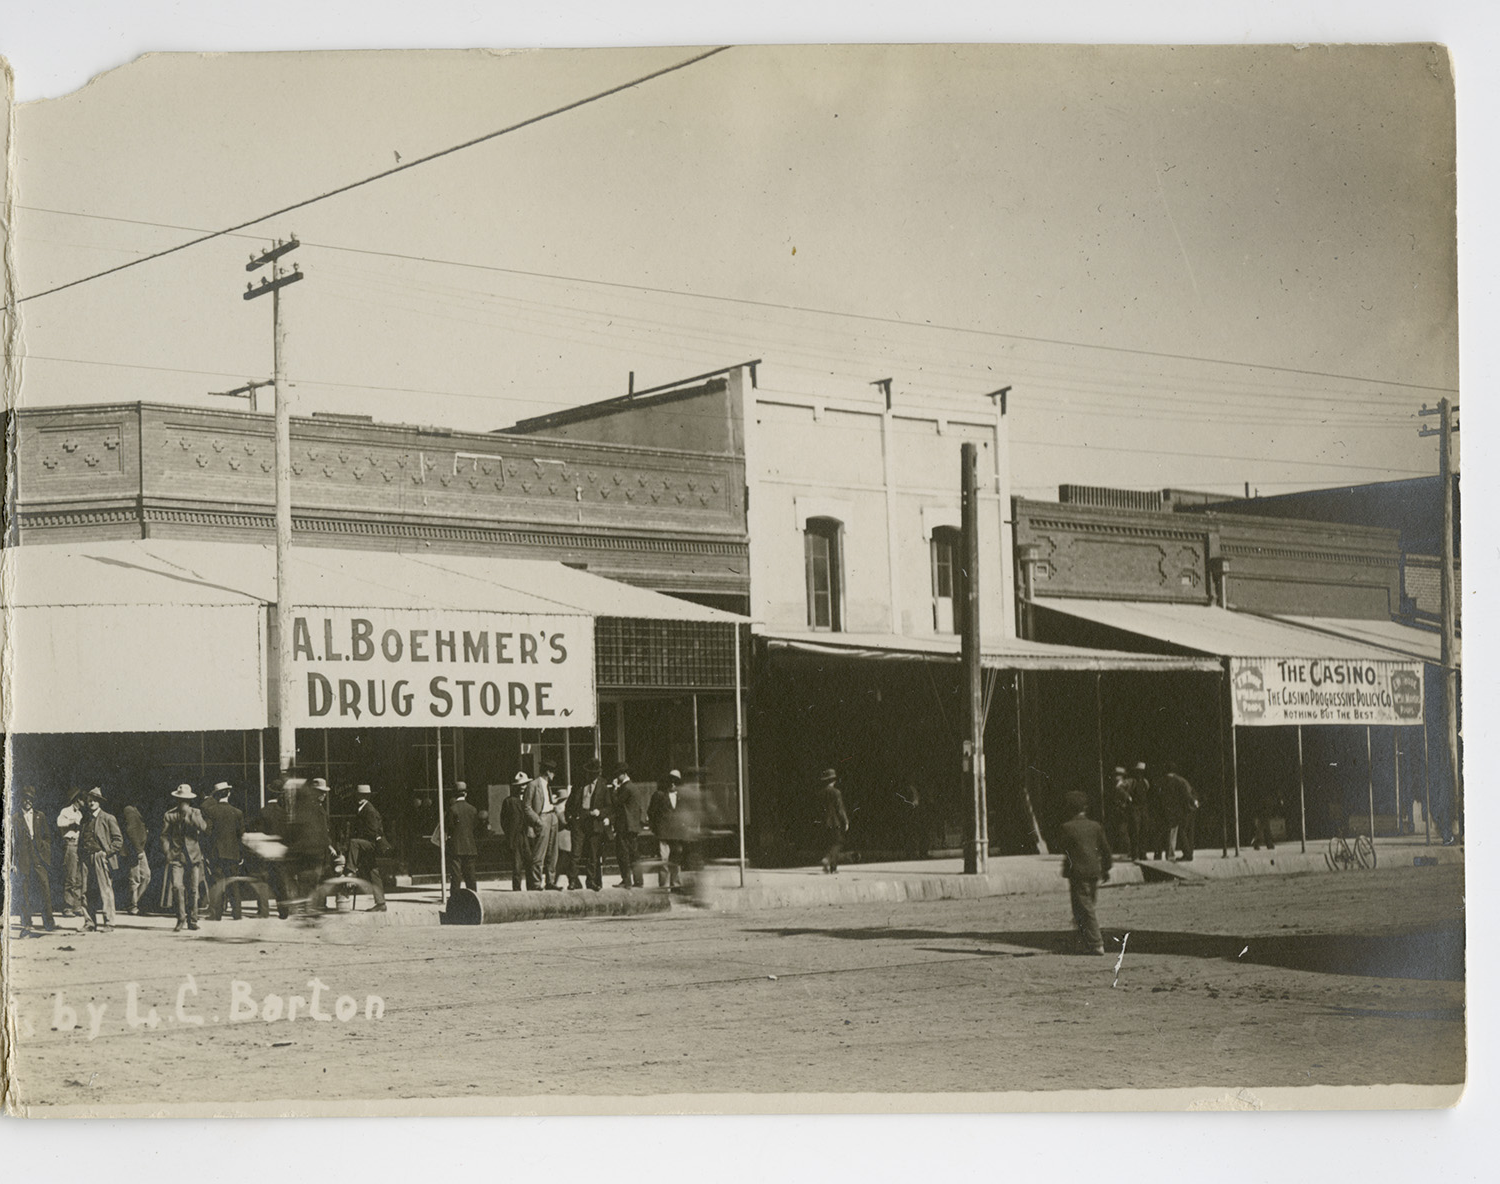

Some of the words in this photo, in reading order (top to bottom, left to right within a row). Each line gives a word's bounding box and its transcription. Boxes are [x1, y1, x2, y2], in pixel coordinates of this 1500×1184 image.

[1278, 661, 1306, 683] THE
[307, 672, 414, 720] DRUG
[1267, 688, 1281, 706] THE
[1282, 687, 1310, 707] CASINO
[1310, 689, 1356, 710] PROGRESSIVE
[1356, 689, 1380, 708] POLICY
[1283, 709, 1317, 719] NOTHING
[1320, 708, 1334, 719] BUT
[1337, 709, 1350, 719] THE
